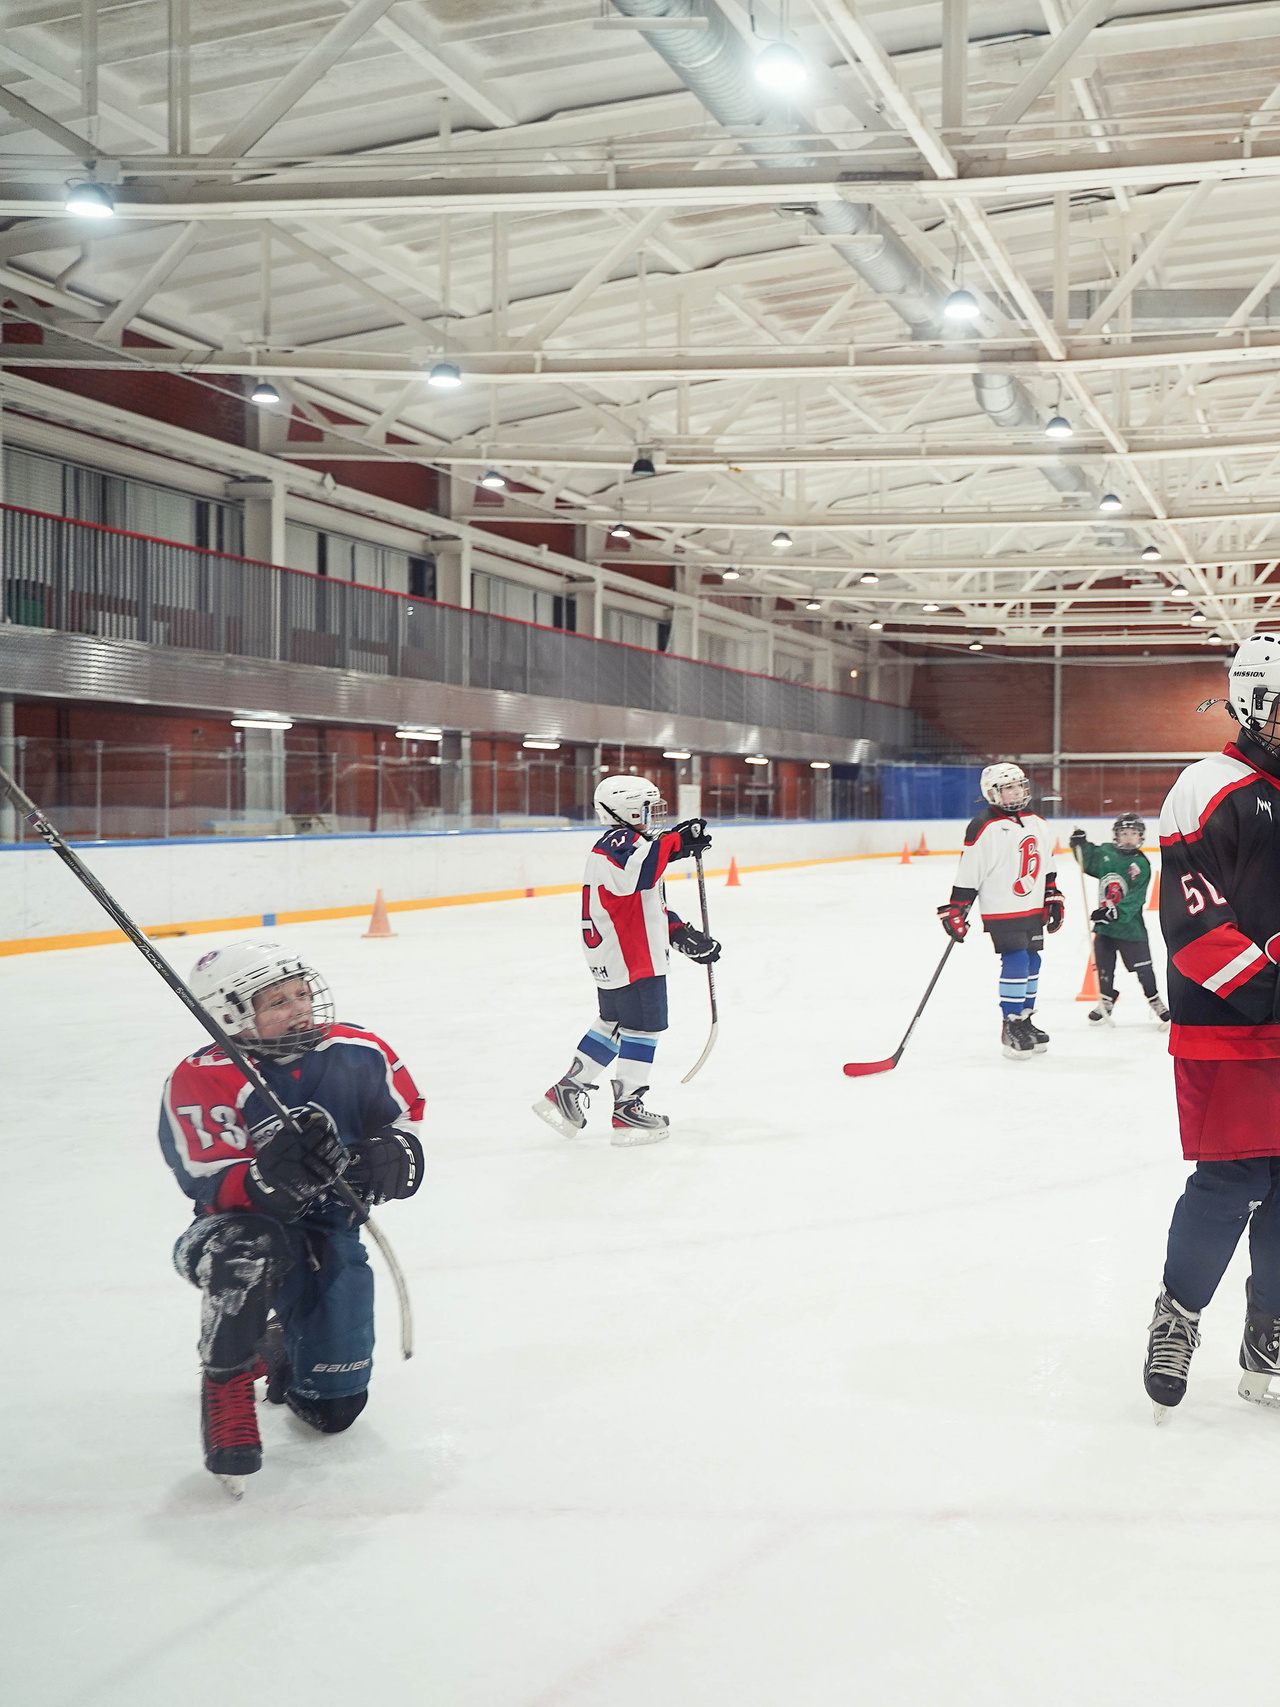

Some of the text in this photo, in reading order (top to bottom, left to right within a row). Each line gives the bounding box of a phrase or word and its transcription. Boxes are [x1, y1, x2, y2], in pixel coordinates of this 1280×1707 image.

[138, 943, 164, 970] TACKS
[176, 1104, 249, 1151] 73
[394, 1134, 416, 1188] EFSI
[312, 1358, 371, 1373] BAUER
